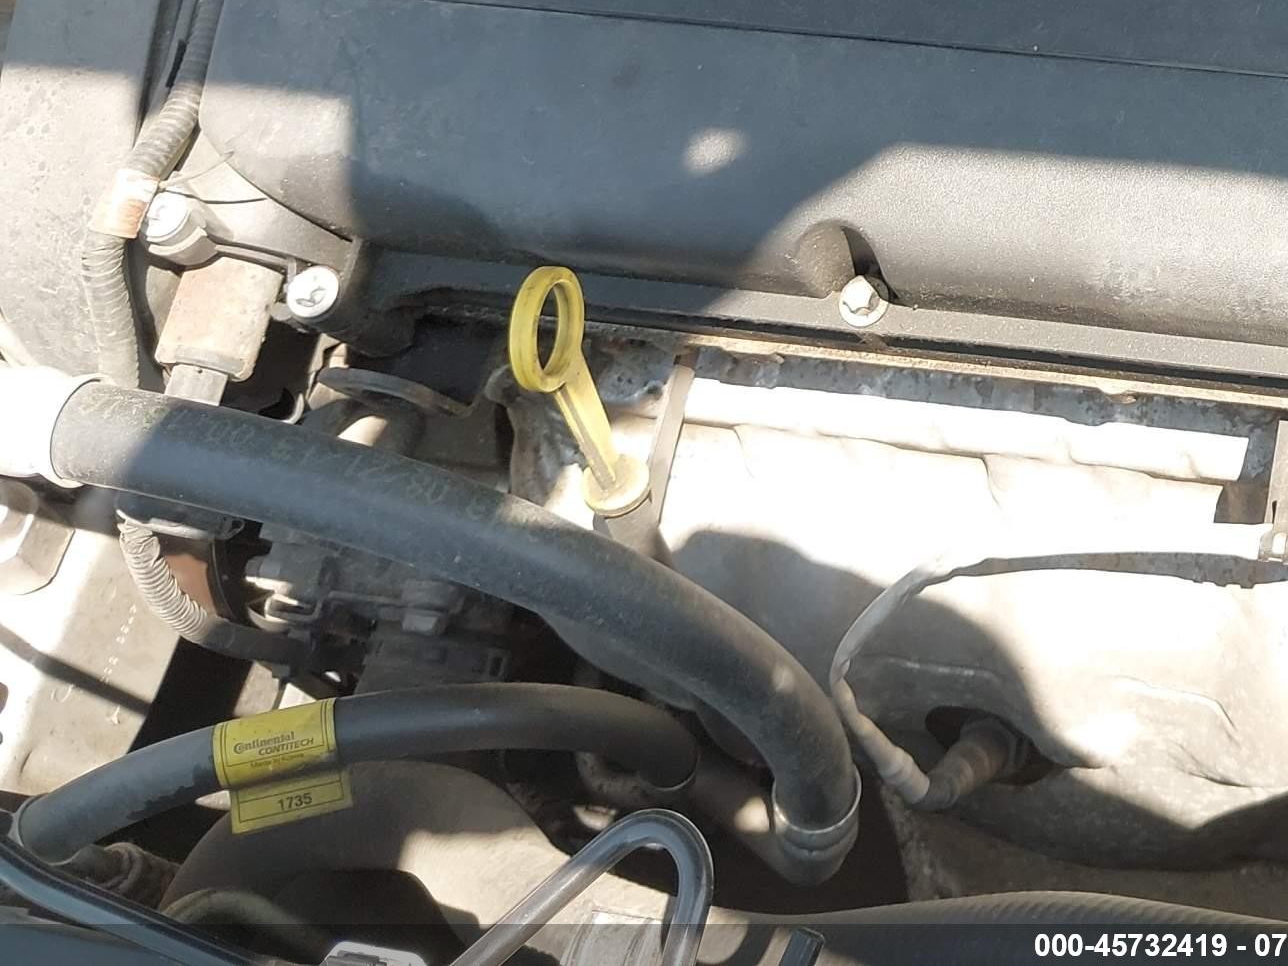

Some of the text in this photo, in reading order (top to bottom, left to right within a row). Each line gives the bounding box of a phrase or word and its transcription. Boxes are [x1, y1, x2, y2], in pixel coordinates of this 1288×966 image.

[233, 730, 295, 755] Continental
[258, 737, 315, 756] CONTITECH
[277, 792, 313, 812] 1735
